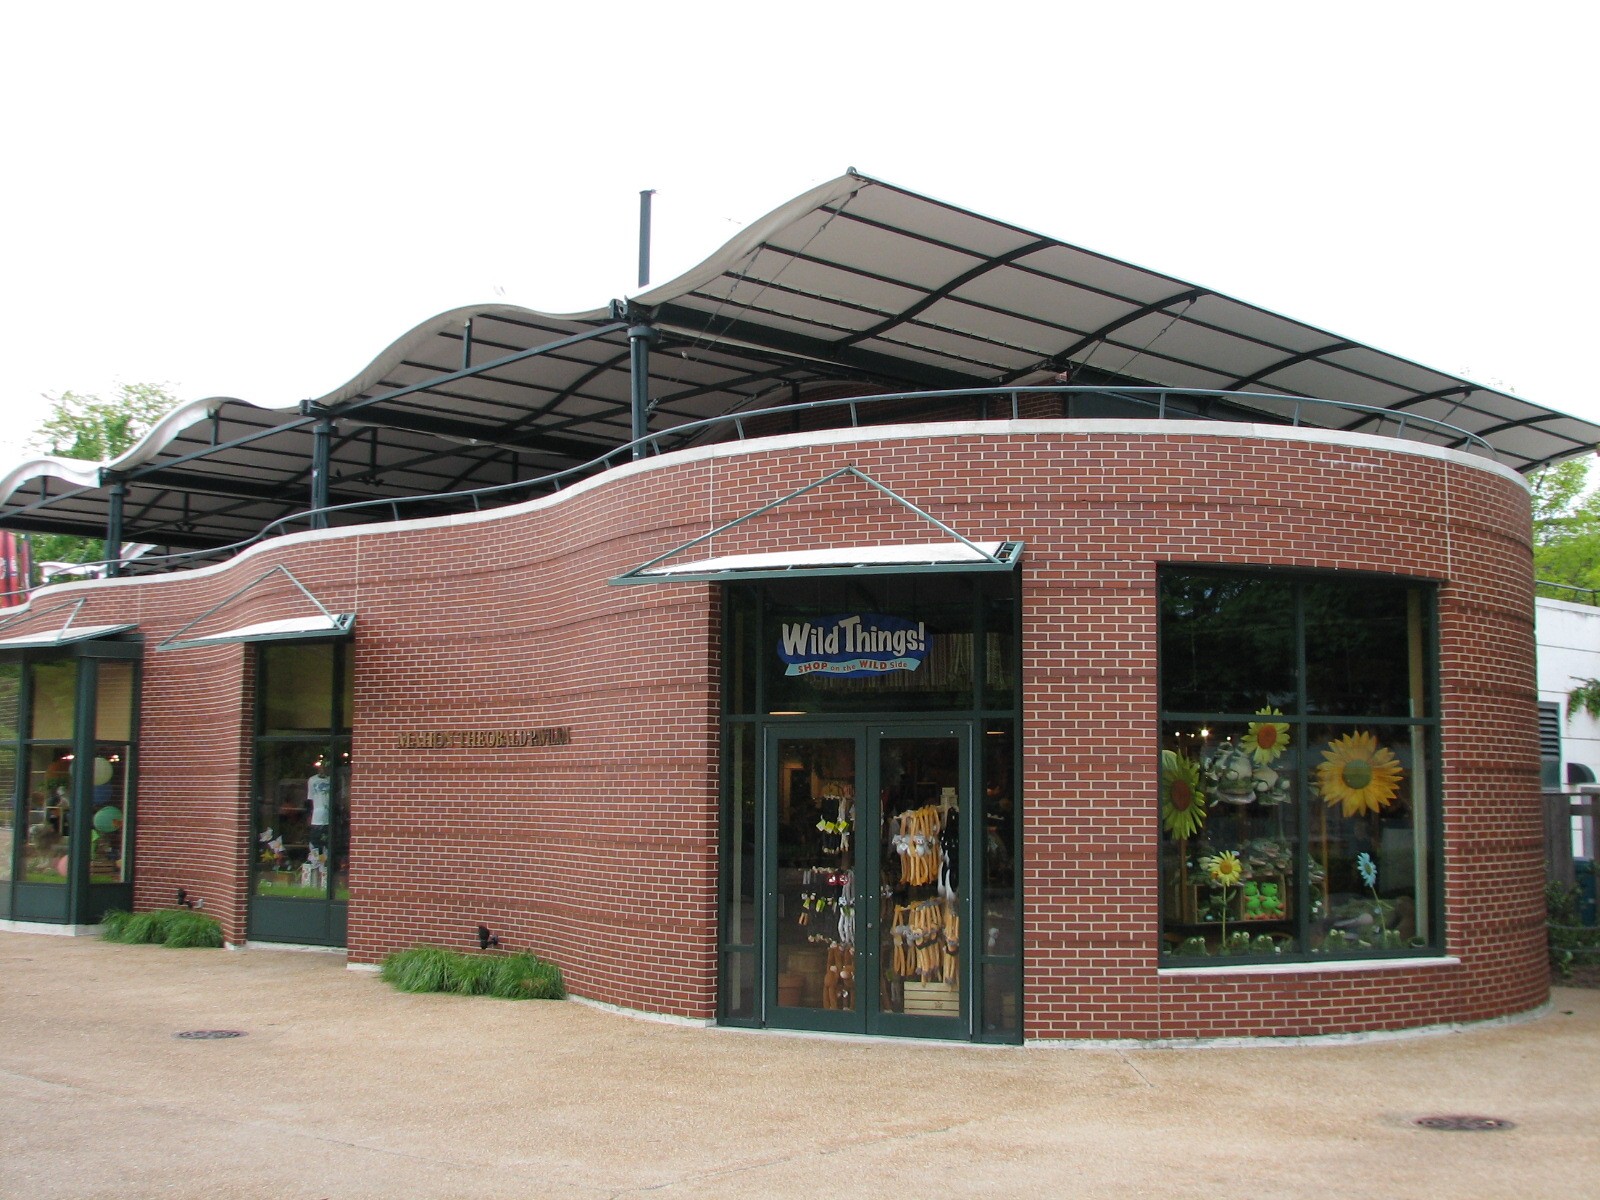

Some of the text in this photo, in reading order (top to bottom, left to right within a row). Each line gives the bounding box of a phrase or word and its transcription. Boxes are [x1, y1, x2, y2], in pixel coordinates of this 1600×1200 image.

[782, 615, 925, 656] Wild Things!
[798, 662, 828, 673] SHOP
[843, 663, 856, 671] the
[859, 660, 887, 669] WILD
[459, 729, 528, 748] THEOBALD
